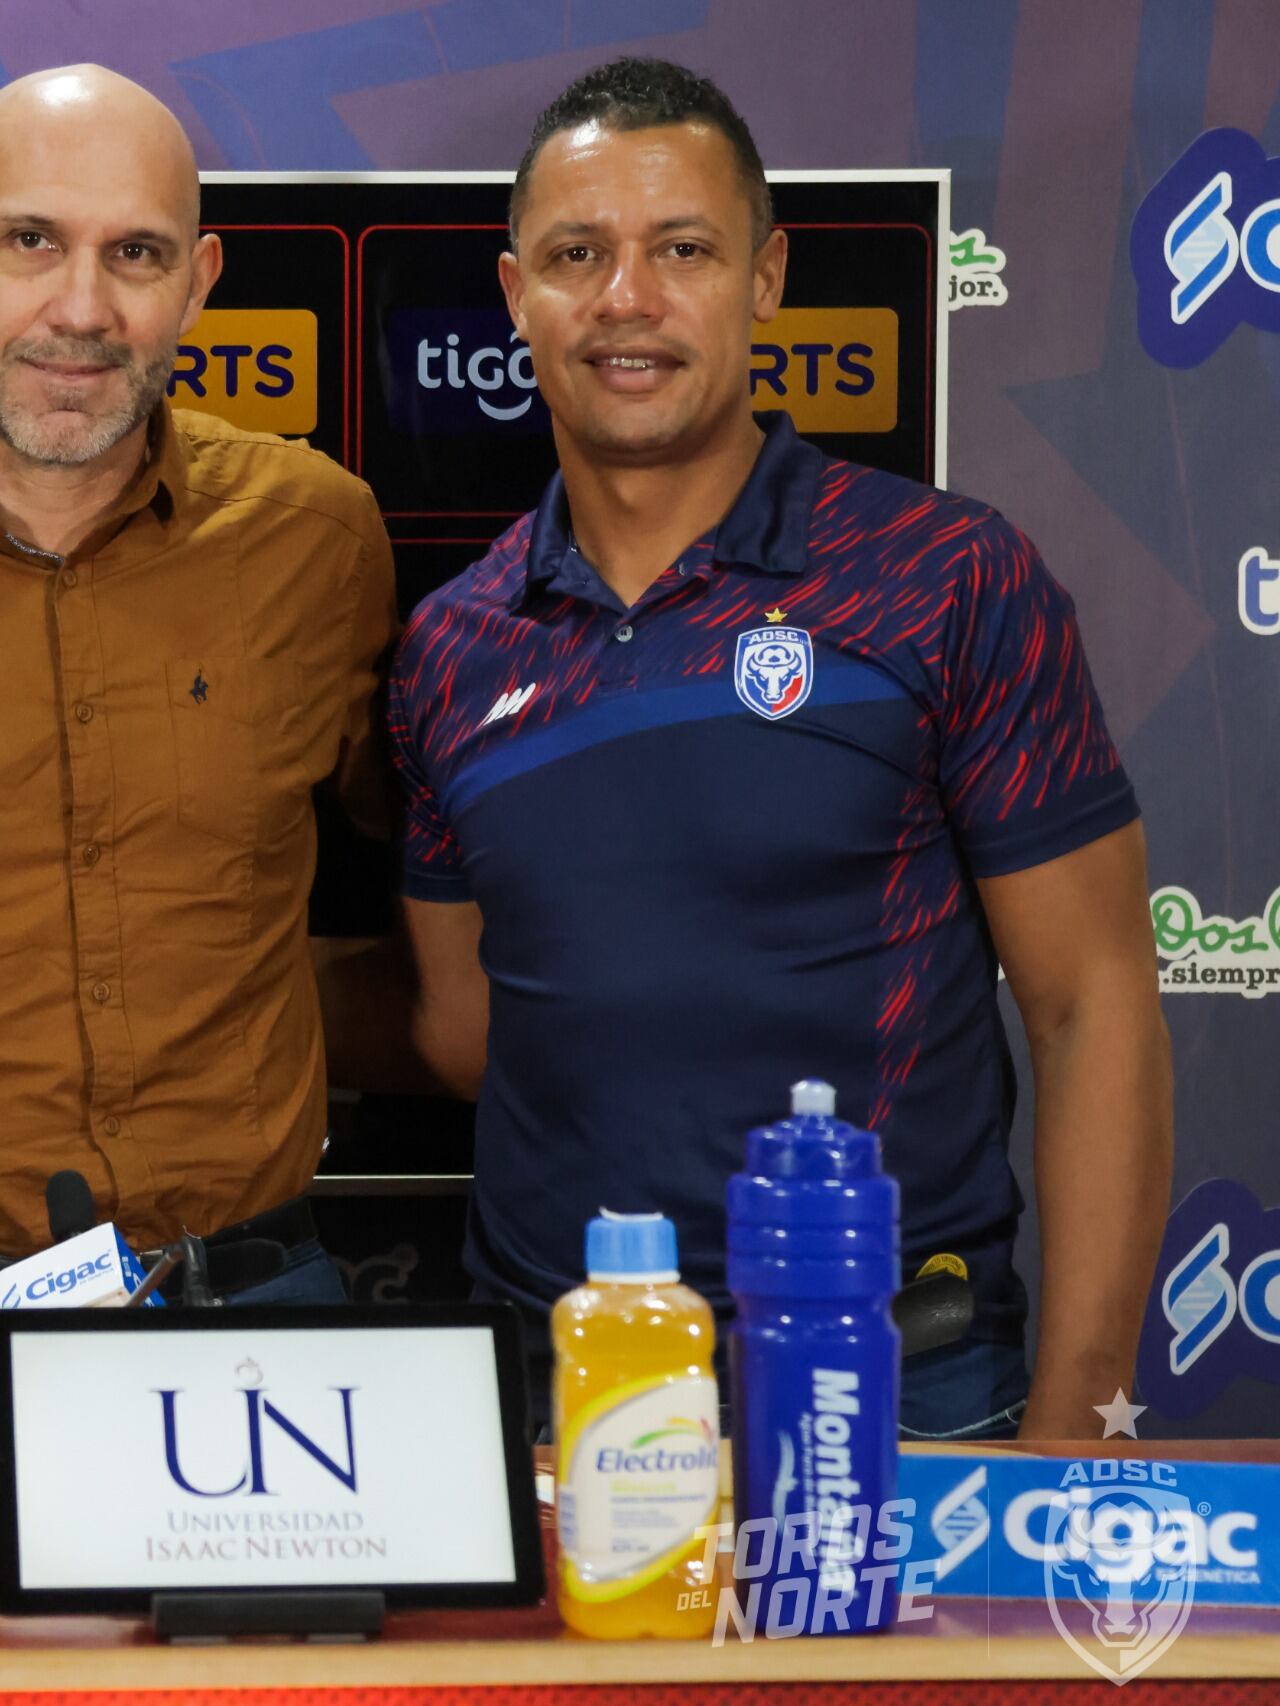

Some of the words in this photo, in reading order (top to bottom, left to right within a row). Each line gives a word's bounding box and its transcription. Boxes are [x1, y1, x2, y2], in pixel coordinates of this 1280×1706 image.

[749, 343, 875, 396] RTS
[748, 631, 799, 645] ADSC
[25, 1252, 112, 1301] Cigac
[1003, 1486, 1259, 1583] Cigac
